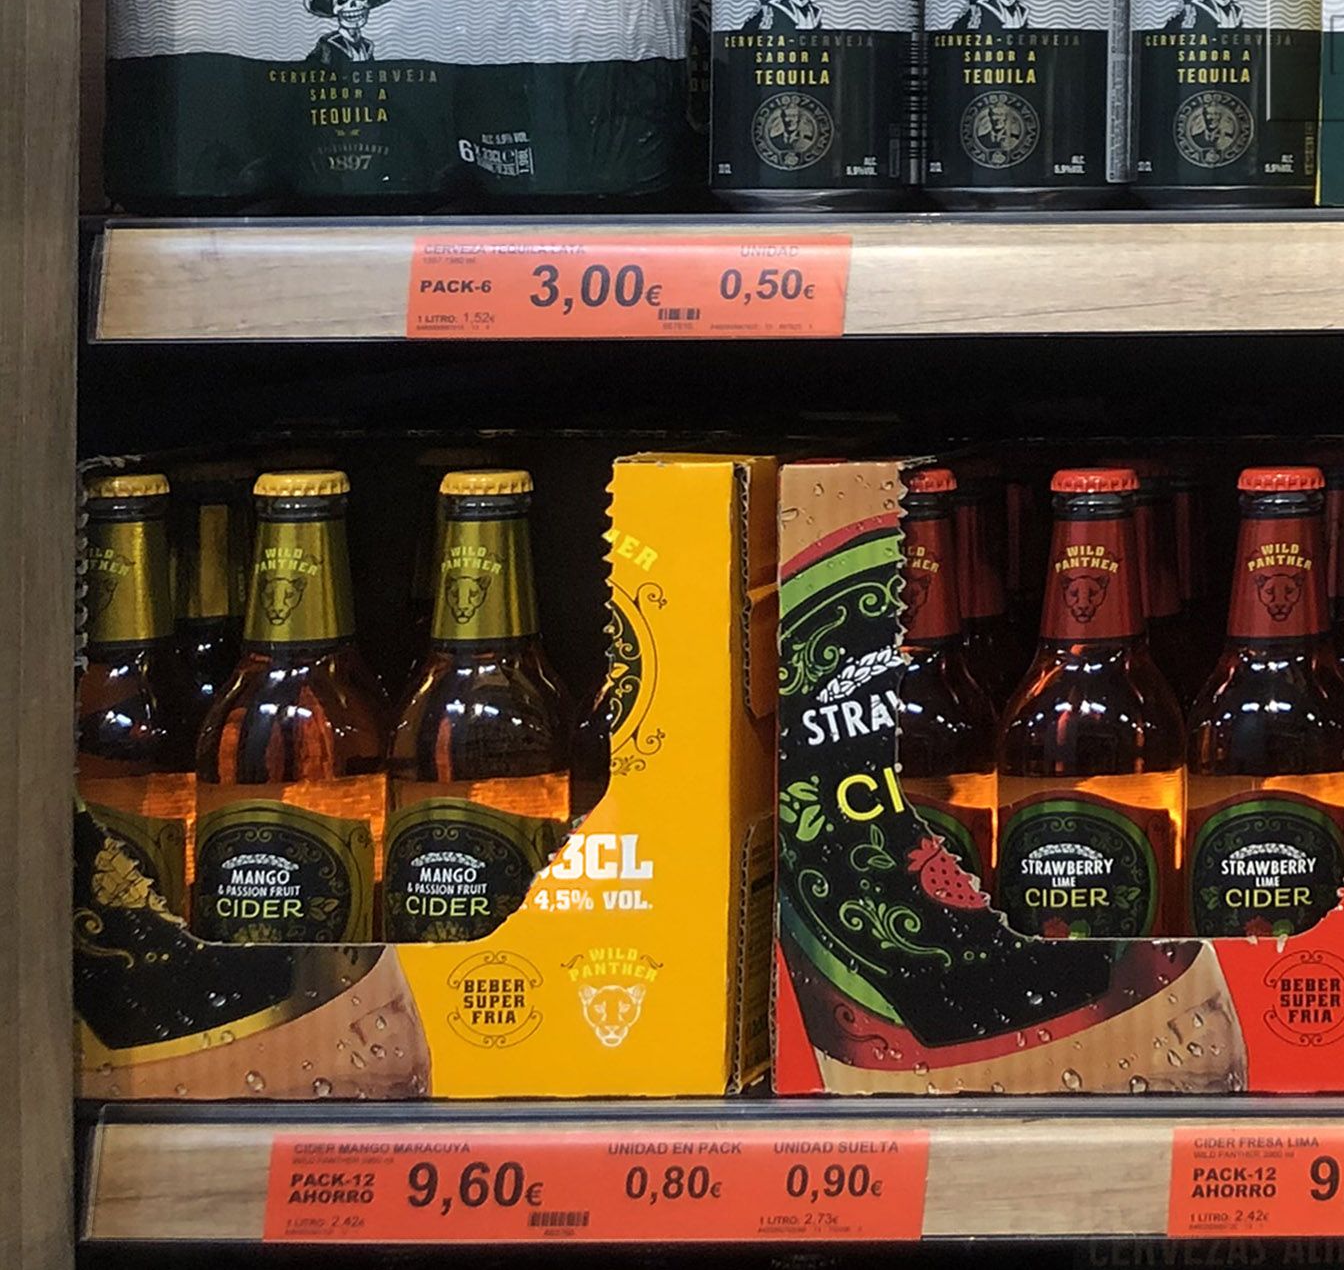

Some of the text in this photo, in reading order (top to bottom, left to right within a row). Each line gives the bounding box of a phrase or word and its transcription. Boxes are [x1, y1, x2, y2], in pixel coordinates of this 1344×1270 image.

[756, 51, 830, 63] SABOR A
[964, 50, 1036, 62] SABOR A
[1178, 50, 1250, 61] SABOR A
[755, 70, 830, 85] TEQUILA
[964, 69, 1036, 84] TEQUILA
[1177, 68, 1250, 83] TEQUILA
[310, 88, 387, 101] SABOR A
[311, 108, 388, 126] TEQUILA
[740, 245, 799, 258] UNIDAD
[420, 279, 492, 294] PACK-6
[530, 264, 662, 315] 3,00€
[720, 268, 816, 305] 0,50€
[265, 547, 303, 560] WILD
[1067, 545, 1104, 557] WILD
[254, 558, 322, 576] PANTHER
[1054, 557, 1119, 574] PANTHER
[1021, 856, 1113, 877] STRAWBERRY
[1221, 856, 1316, 877] STRAWBERRY
[231, 869, 290, 886] MANGO
[1052, 877, 1076, 888] LIME
[1256, 877, 1280, 888] LIME
[217, 885, 301, 896] & PASSION FRUIT
[1225, 887, 1313, 909] CIDER
[534, 890, 653, 911] 4,5% VOL.
[1024, 888, 1110, 909] CIDER
[216, 898, 304, 919] CIDER
[464, 978, 525, 993] BEBER
[1280, 978, 1340, 992] BEBER
[463, 994, 525, 1009] SUPER
[1280, 993, 1341, 1008] SUPER
[472, 1010, 517, 1025] FRIA
[1288, 1009, 1333, 1024] FRIA
[294, 1142, 470, 1155] CIDER MANGO MARACUYA
[774, 1141, 899, 1154] UNIDAD SUELTA
[1194, 1137, 1319, 1149] CIDER FRESA LIMA
[290, 1173, 375, 1187] PACK-12
[1192, 1167, 1276, 1181] PACK-12
[407, 1161, 543, 1216] 9,60€
[626, 1166, 722, 1205] 0,80€
[786, 1164, 883, 1203] 0,90€
[1191, 1184, 1276, 1198] AHORRO
[288, 1190, 374, 1204] AHORRO
